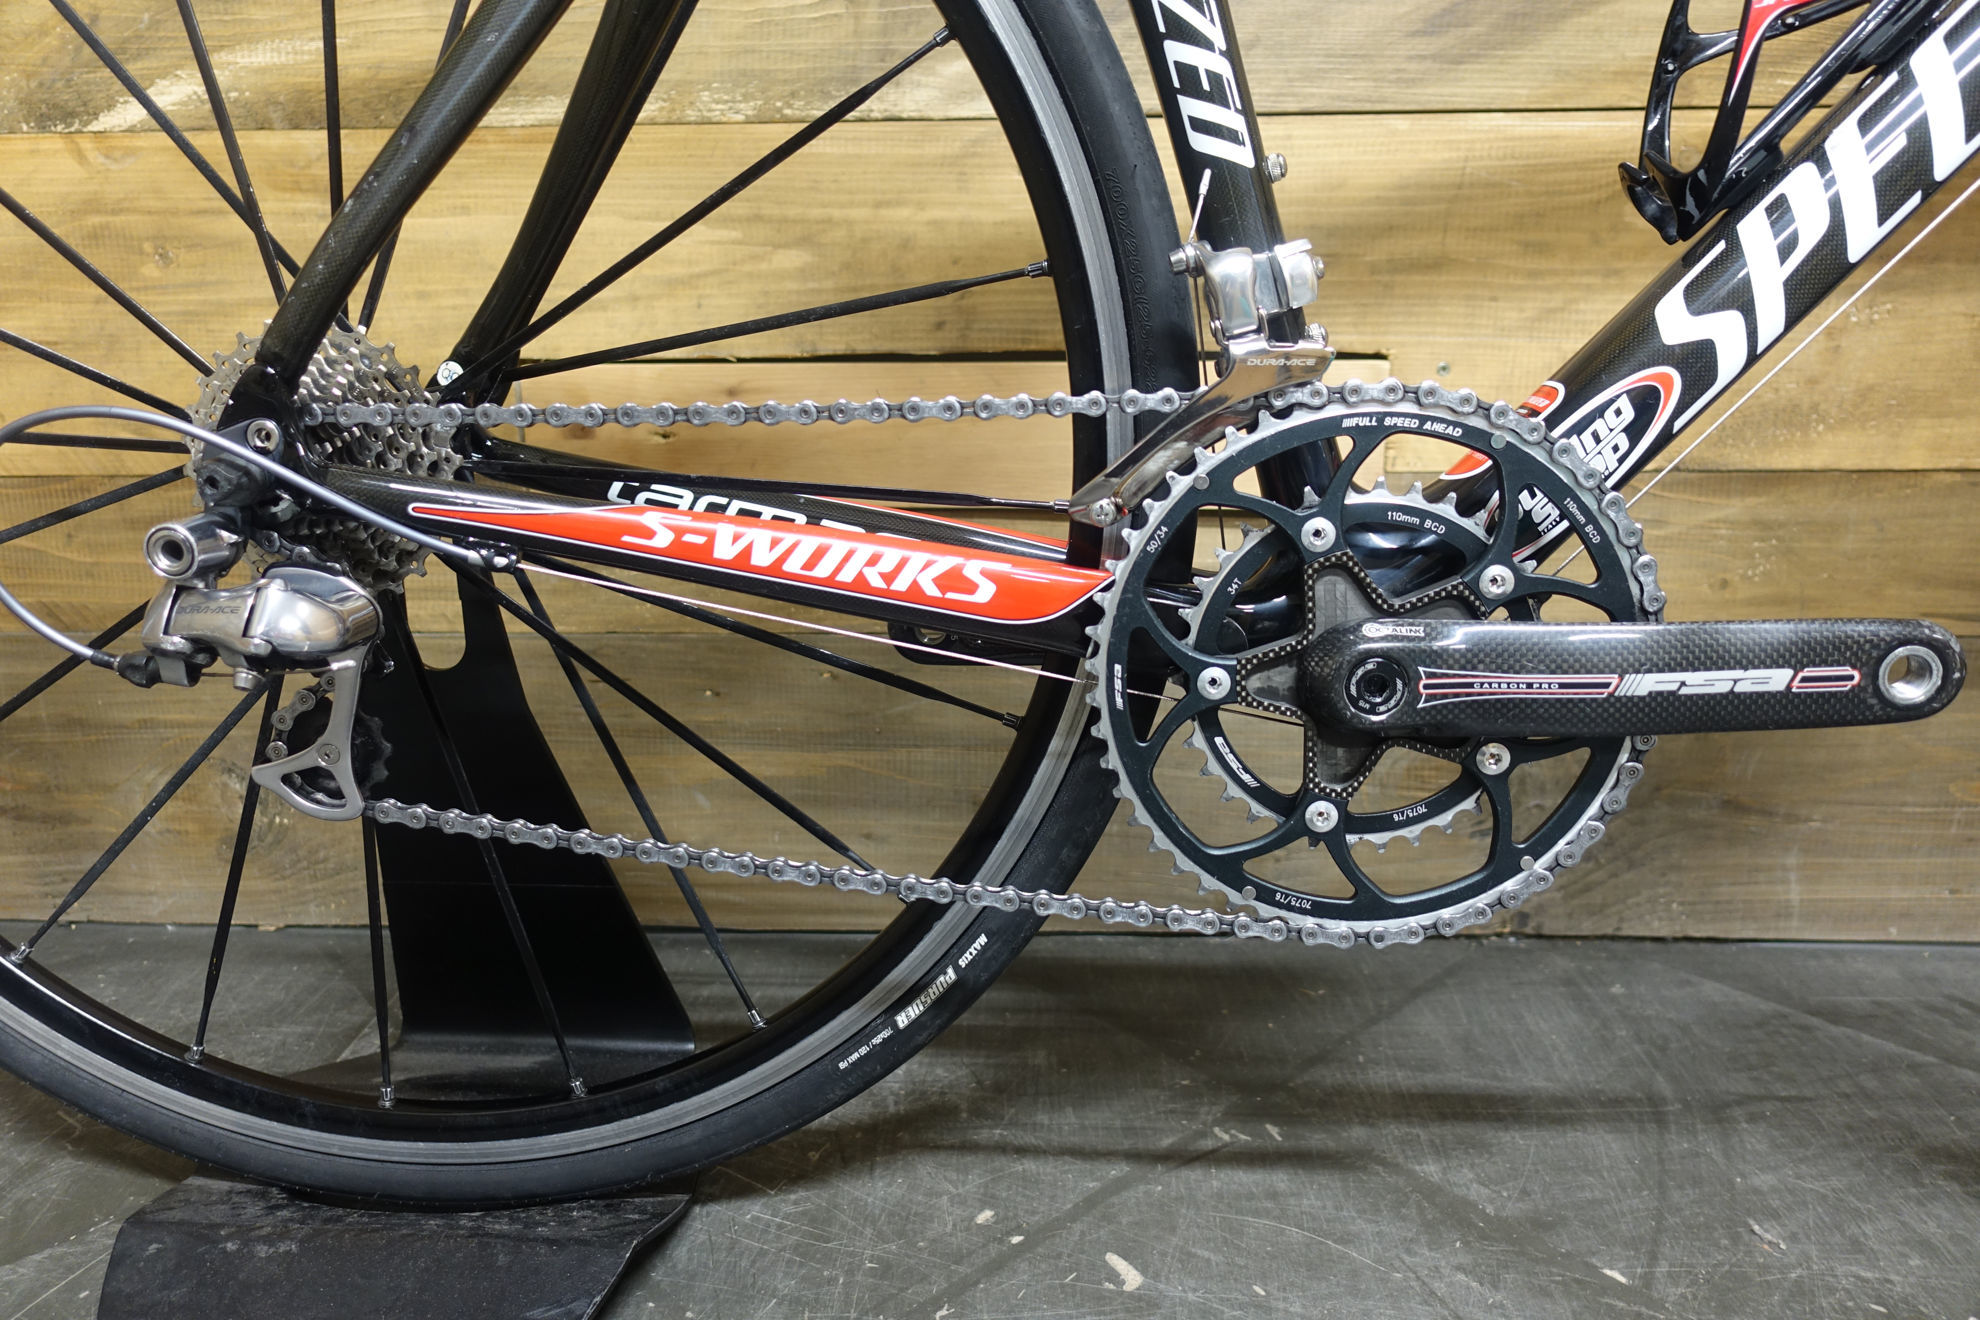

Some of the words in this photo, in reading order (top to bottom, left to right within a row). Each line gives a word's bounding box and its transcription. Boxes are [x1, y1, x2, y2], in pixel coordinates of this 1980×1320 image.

[1246, 357, 1316, 367] DURA-ACE
[1353, 416, 1378, 428] FULL
[1384, 416, 1418, 430] SPEED
[1424, 420, 1463, 437] AHEAD
[1387, 511, 1420, 527] 110mm
[1424, 519, 1446, 534] BCD
[1563, 497, 1586, 529] 110mm
[1581, 522, 1601, 544] BCD
[1146, 525, 1169, 553] 50/34
[621, 510, 1014, 604] S-WORKS
[1228, 580, 1243, 596] 34T
[1473, 682, 1527, 690] CARBON
[1532, 681, 1559, 690] PRO
[1632, 668, 1795, 697] FSA
[1392, 804, 1428, 822] 7075/T6
[1273, 891, 1312, 911] 7075/T6
[958, 933, 988, 969] MAXXIS
[894, 965, 958, 1030] PURSUER
[848, 1053, 860, 1065] MAX
